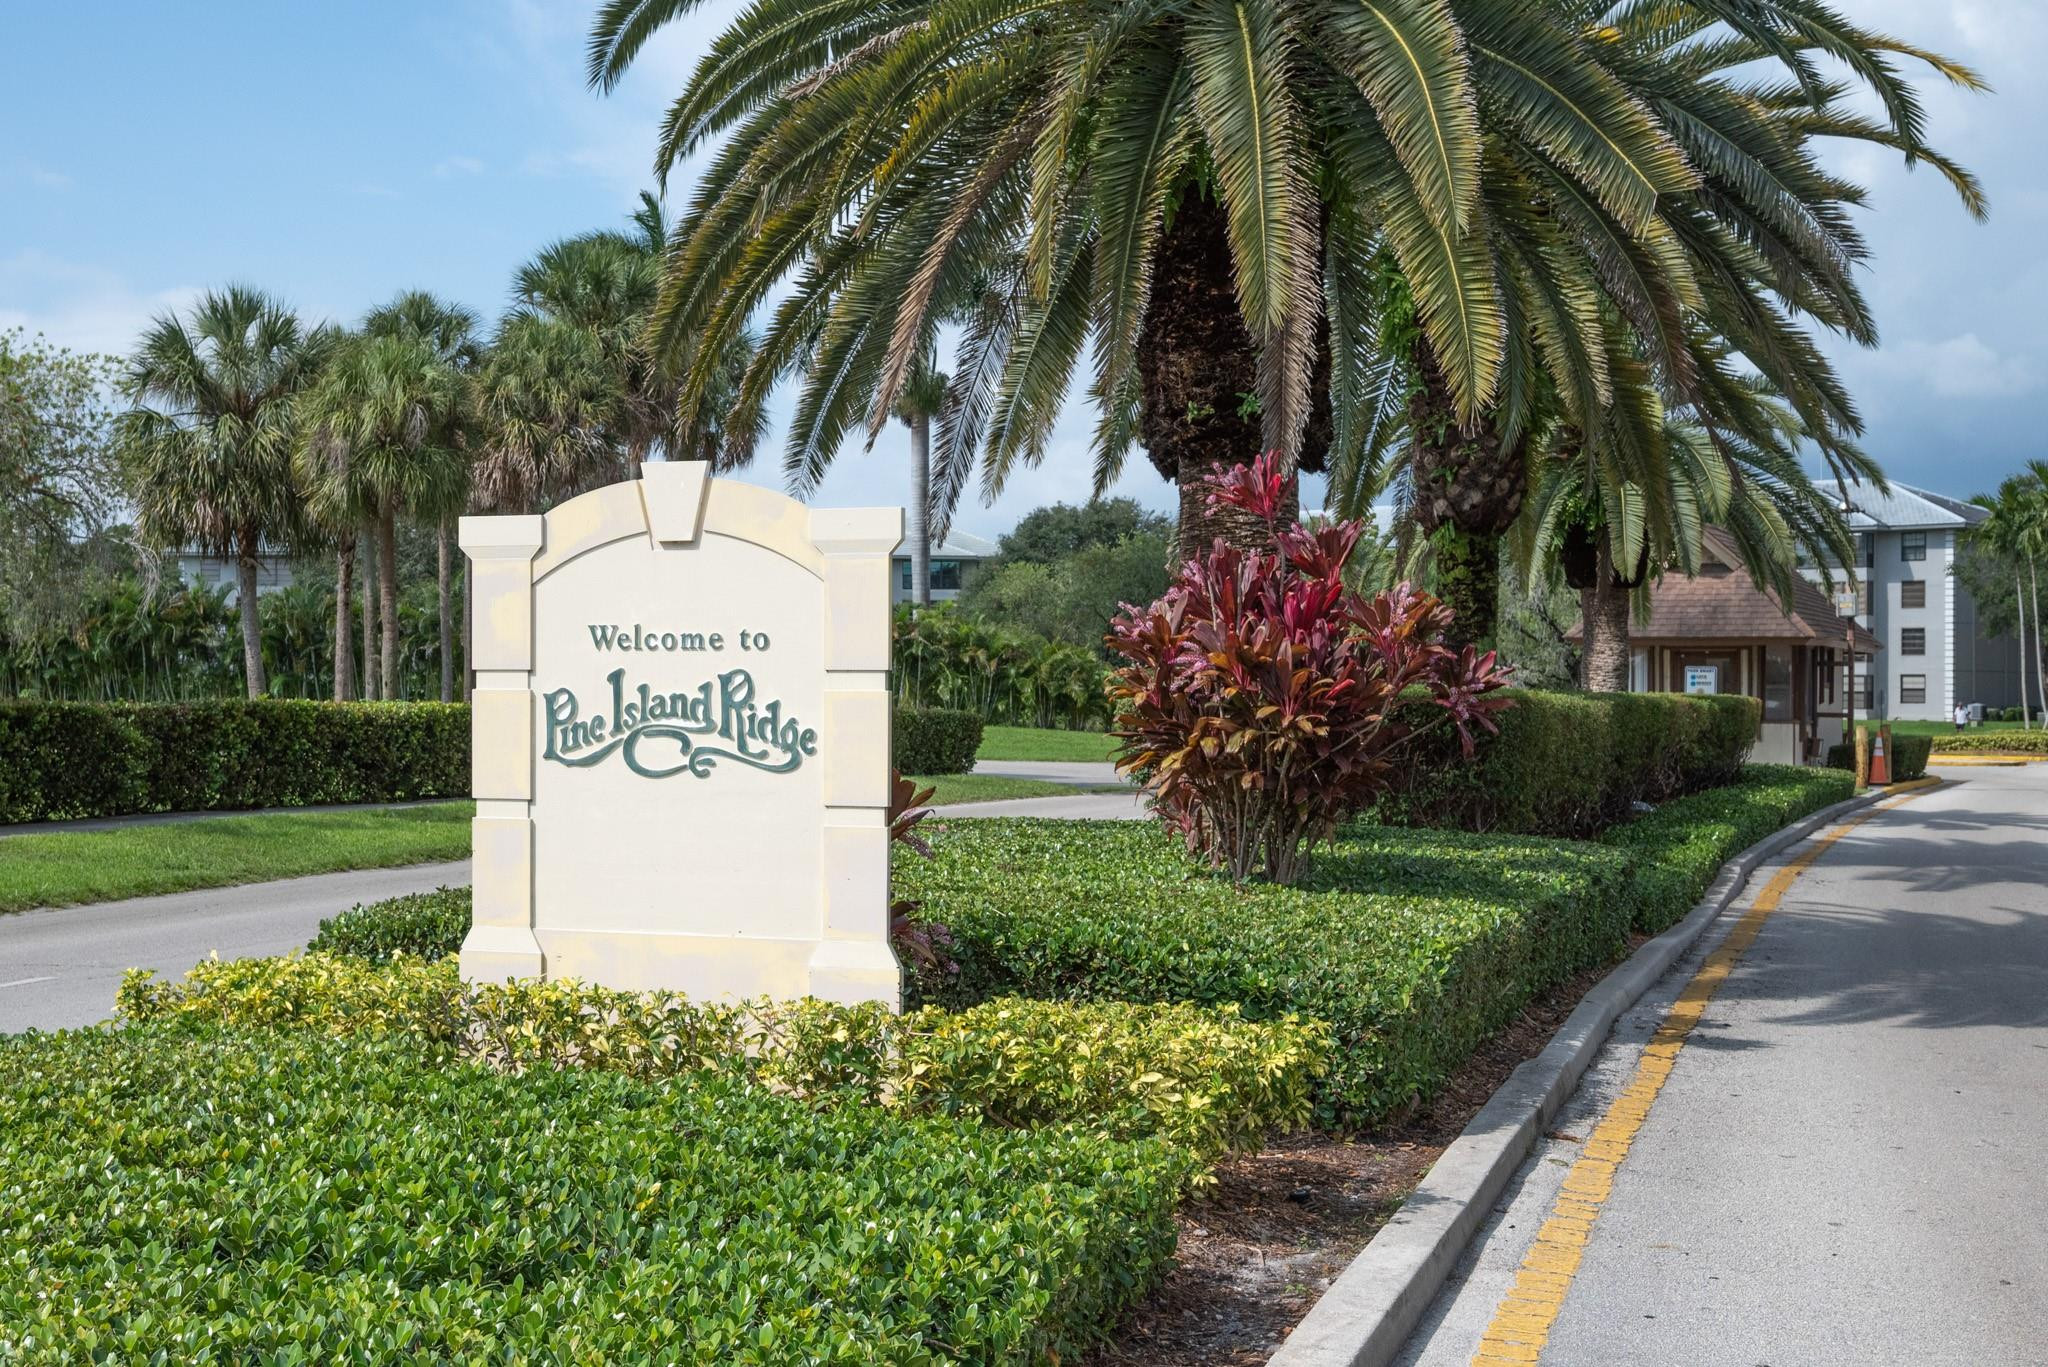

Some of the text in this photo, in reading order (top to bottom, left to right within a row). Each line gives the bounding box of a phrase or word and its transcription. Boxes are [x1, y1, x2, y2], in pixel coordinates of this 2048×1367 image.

[588, 624, 771, 652] Welcome to
[542, 667, 818, 773] Pine Island Ridge
